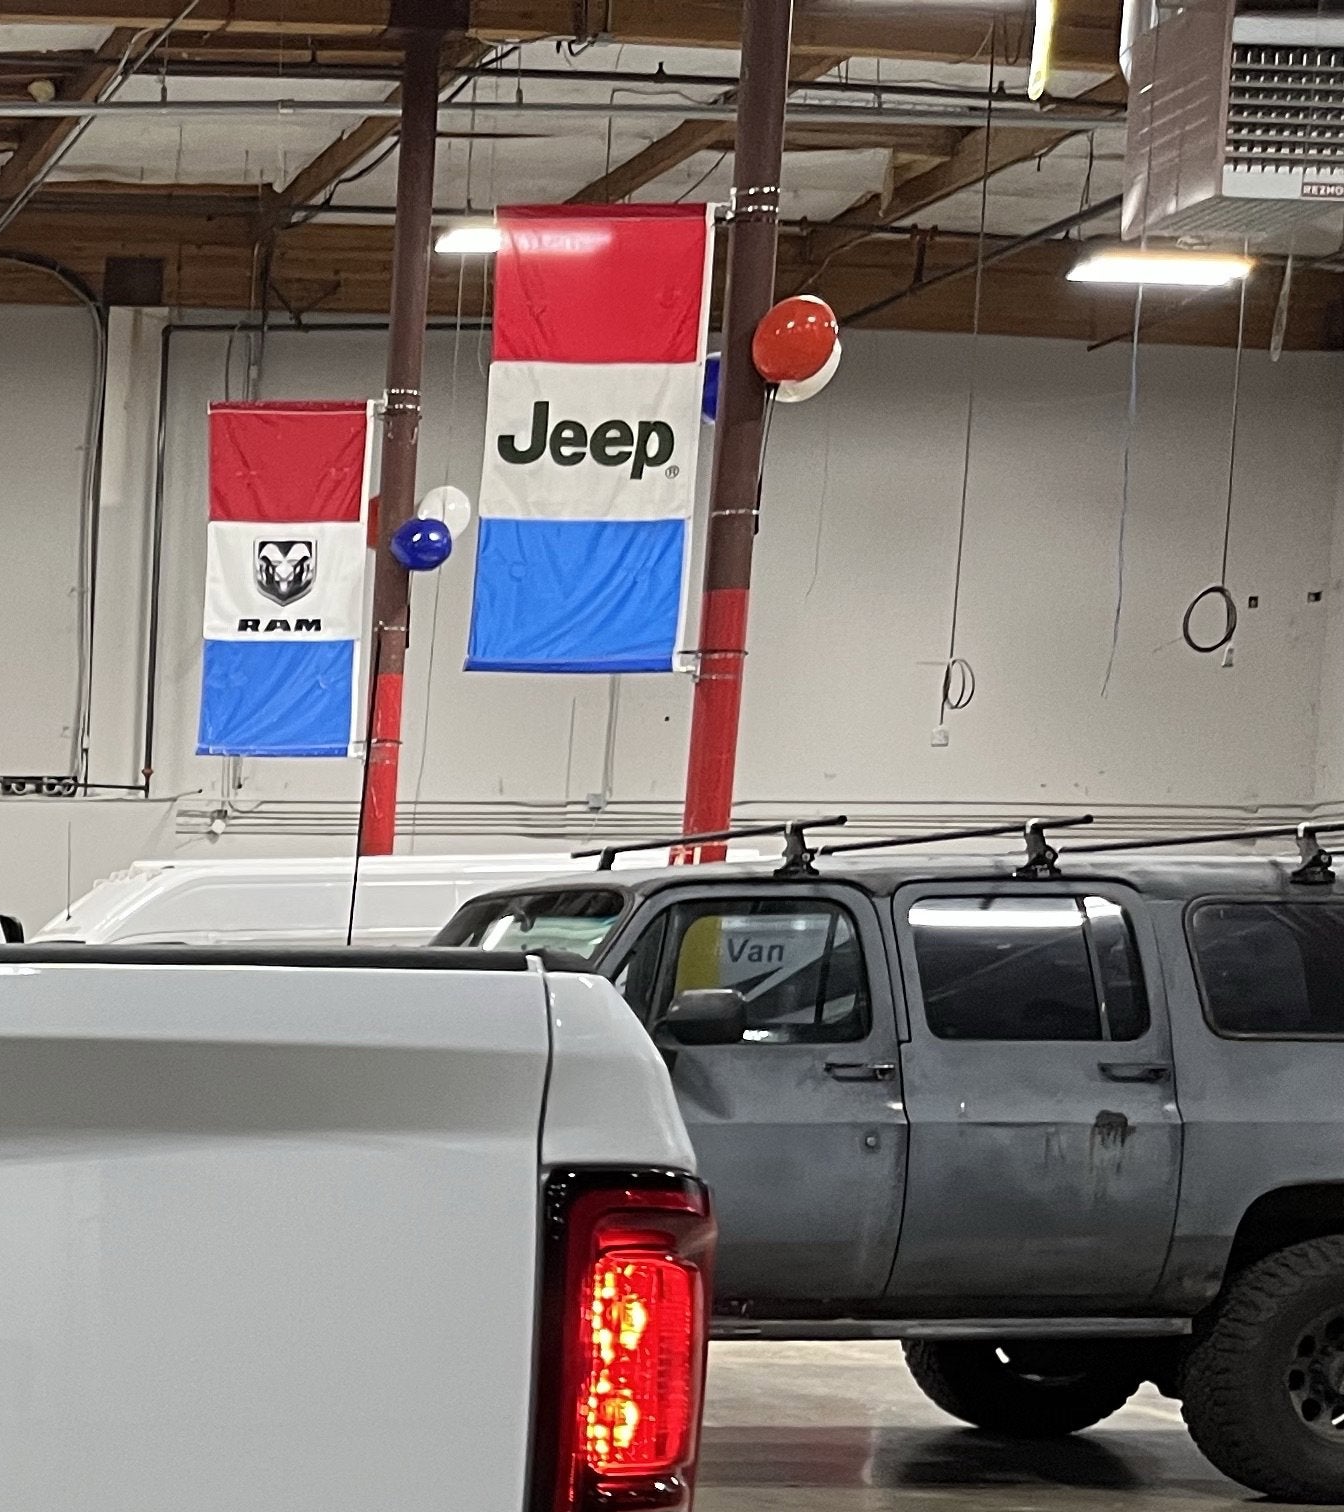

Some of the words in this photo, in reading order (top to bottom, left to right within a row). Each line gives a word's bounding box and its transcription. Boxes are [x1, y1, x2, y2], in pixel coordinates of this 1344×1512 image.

[497, 401, 675, 480] Jeep
[237, 619, 322, 632] RAM
[728, 938, 785, 963] Van
